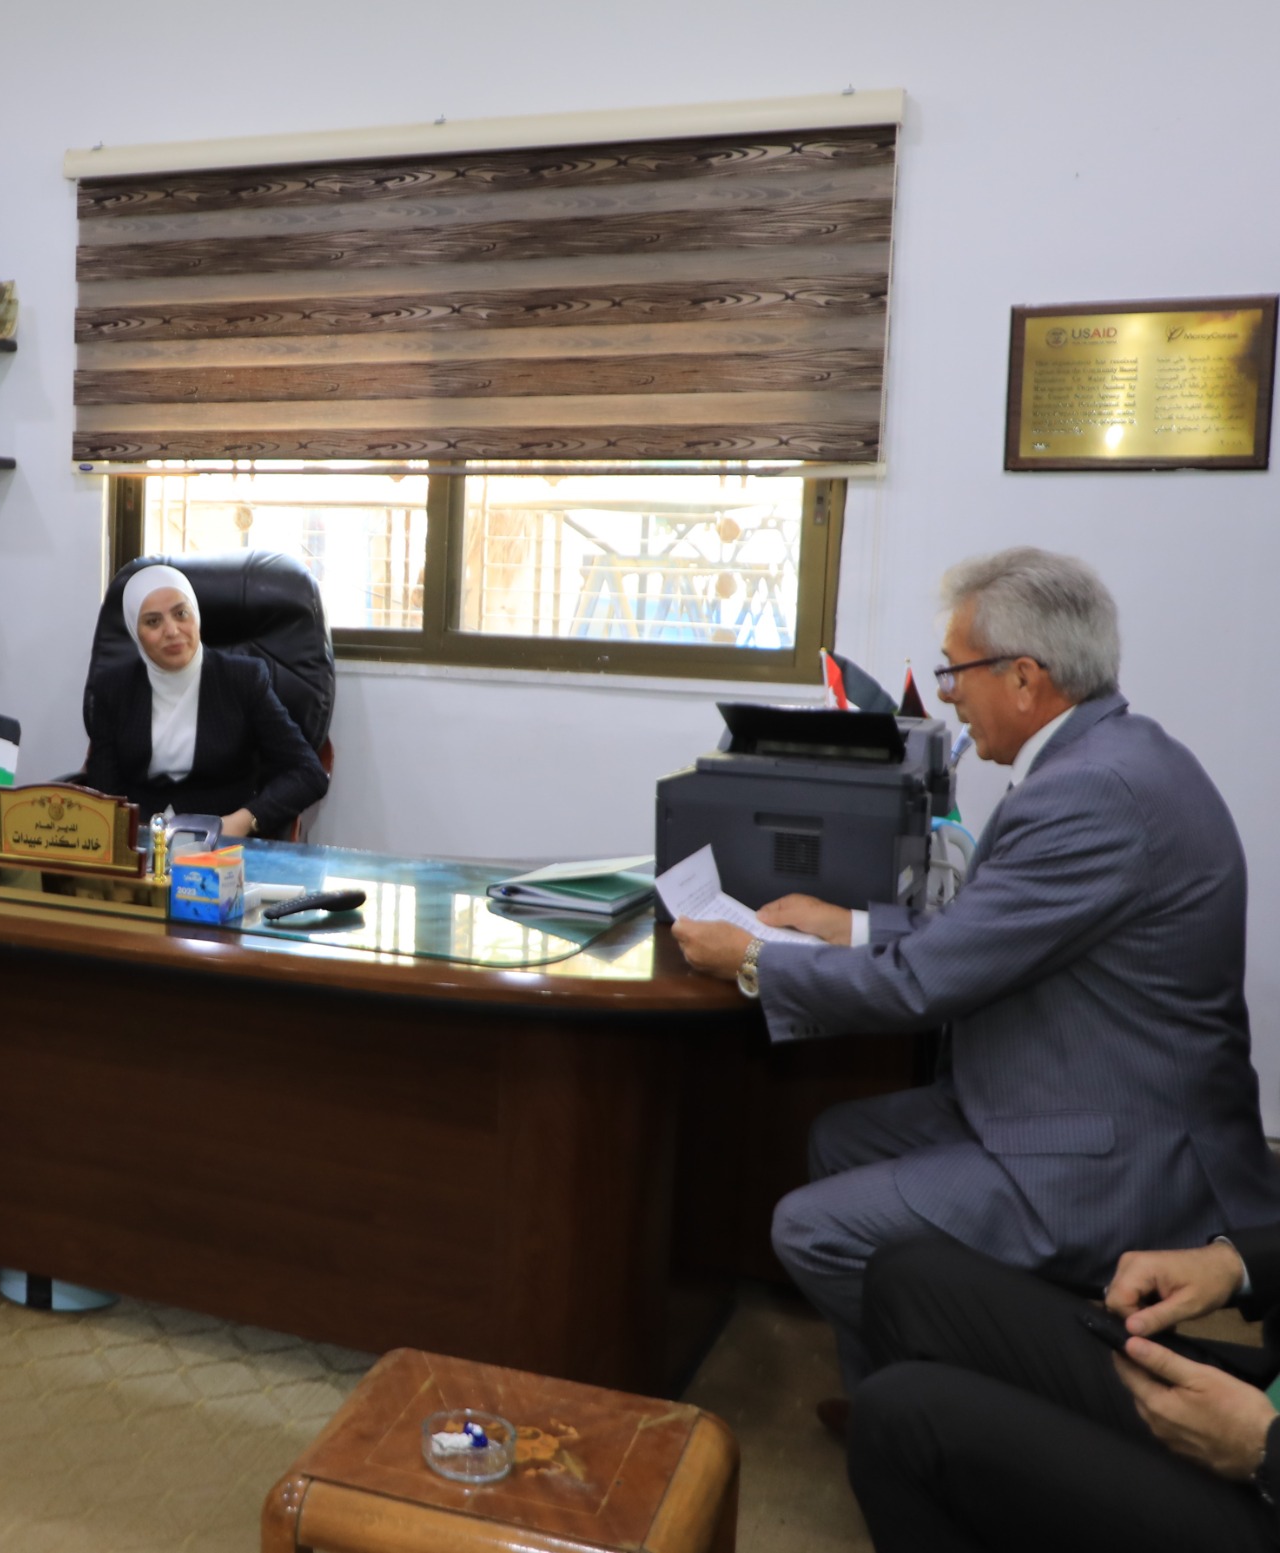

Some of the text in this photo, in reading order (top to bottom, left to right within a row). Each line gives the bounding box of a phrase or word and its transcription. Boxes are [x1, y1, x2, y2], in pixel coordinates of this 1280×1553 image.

[1071, 327, 1117, 339] USAID
[12, 830, 43, 848] عبيدات
[81, 837, 102, 851] خالد
